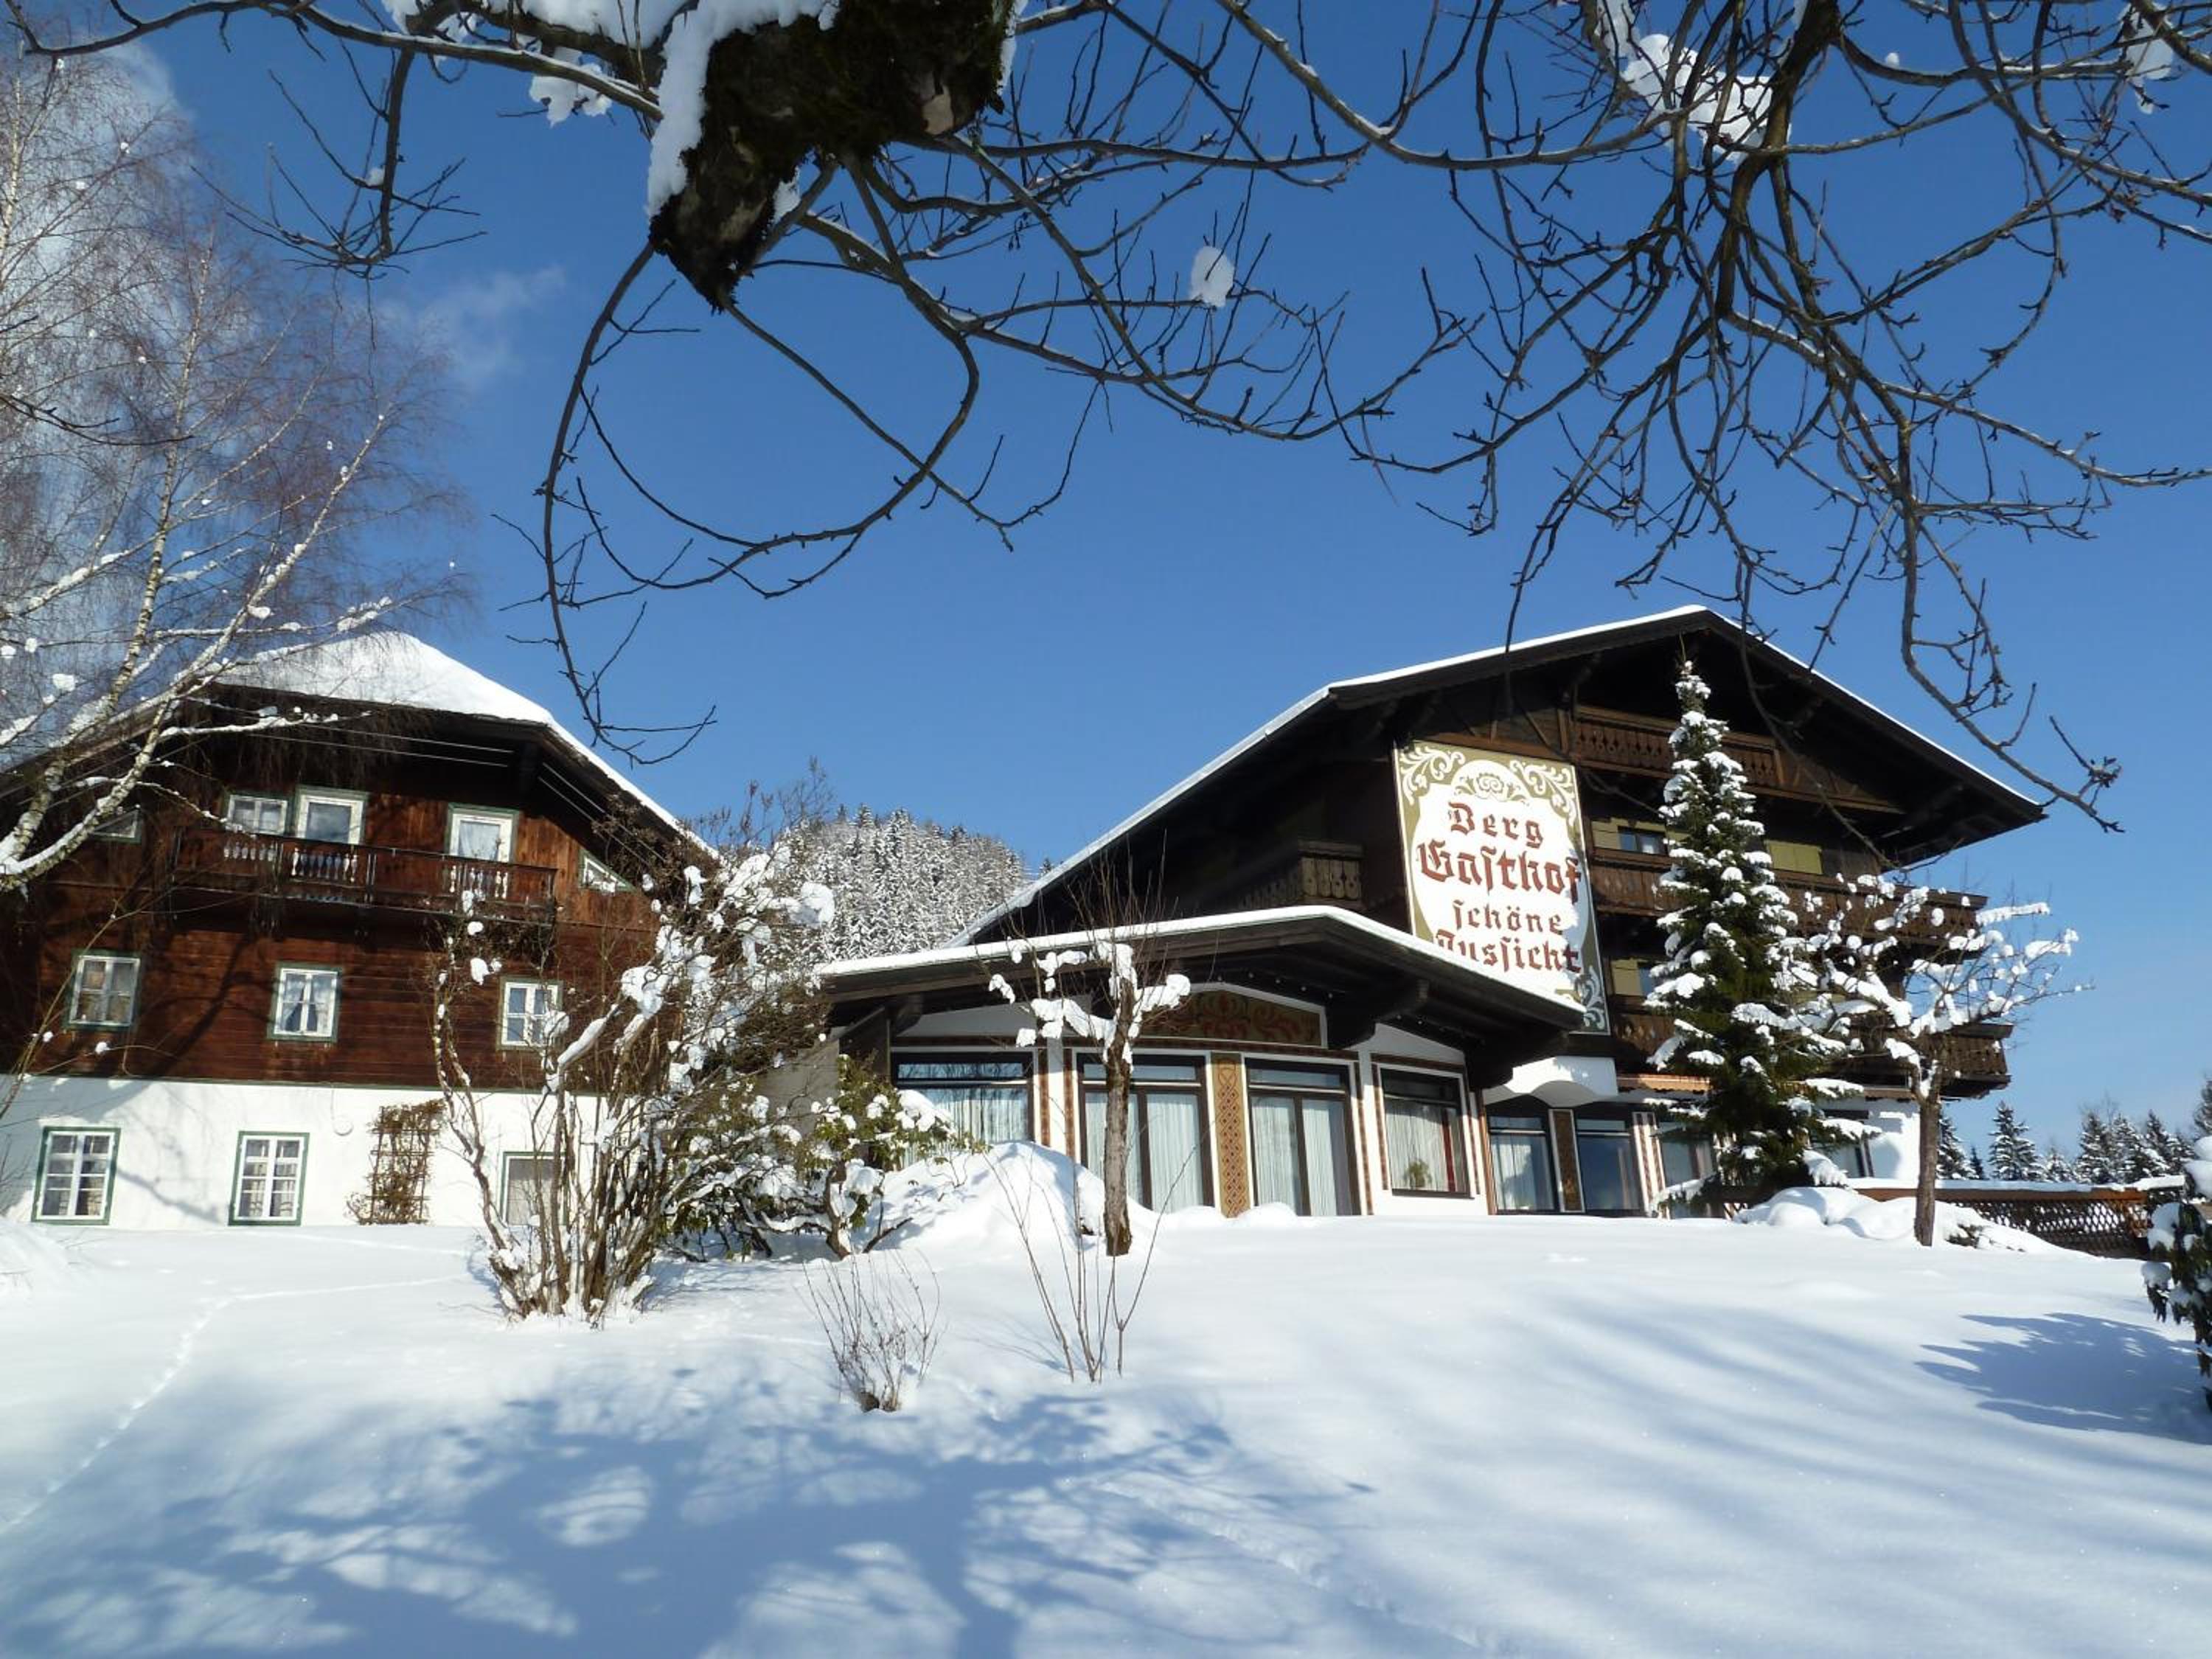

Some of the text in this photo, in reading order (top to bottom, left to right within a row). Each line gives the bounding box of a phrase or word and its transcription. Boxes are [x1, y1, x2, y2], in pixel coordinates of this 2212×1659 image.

[1448, 801, 1544, 849] Berg
[1417, 839, 1582, 905] Gasthof
[1453, 900, 1563, 935] schöne
